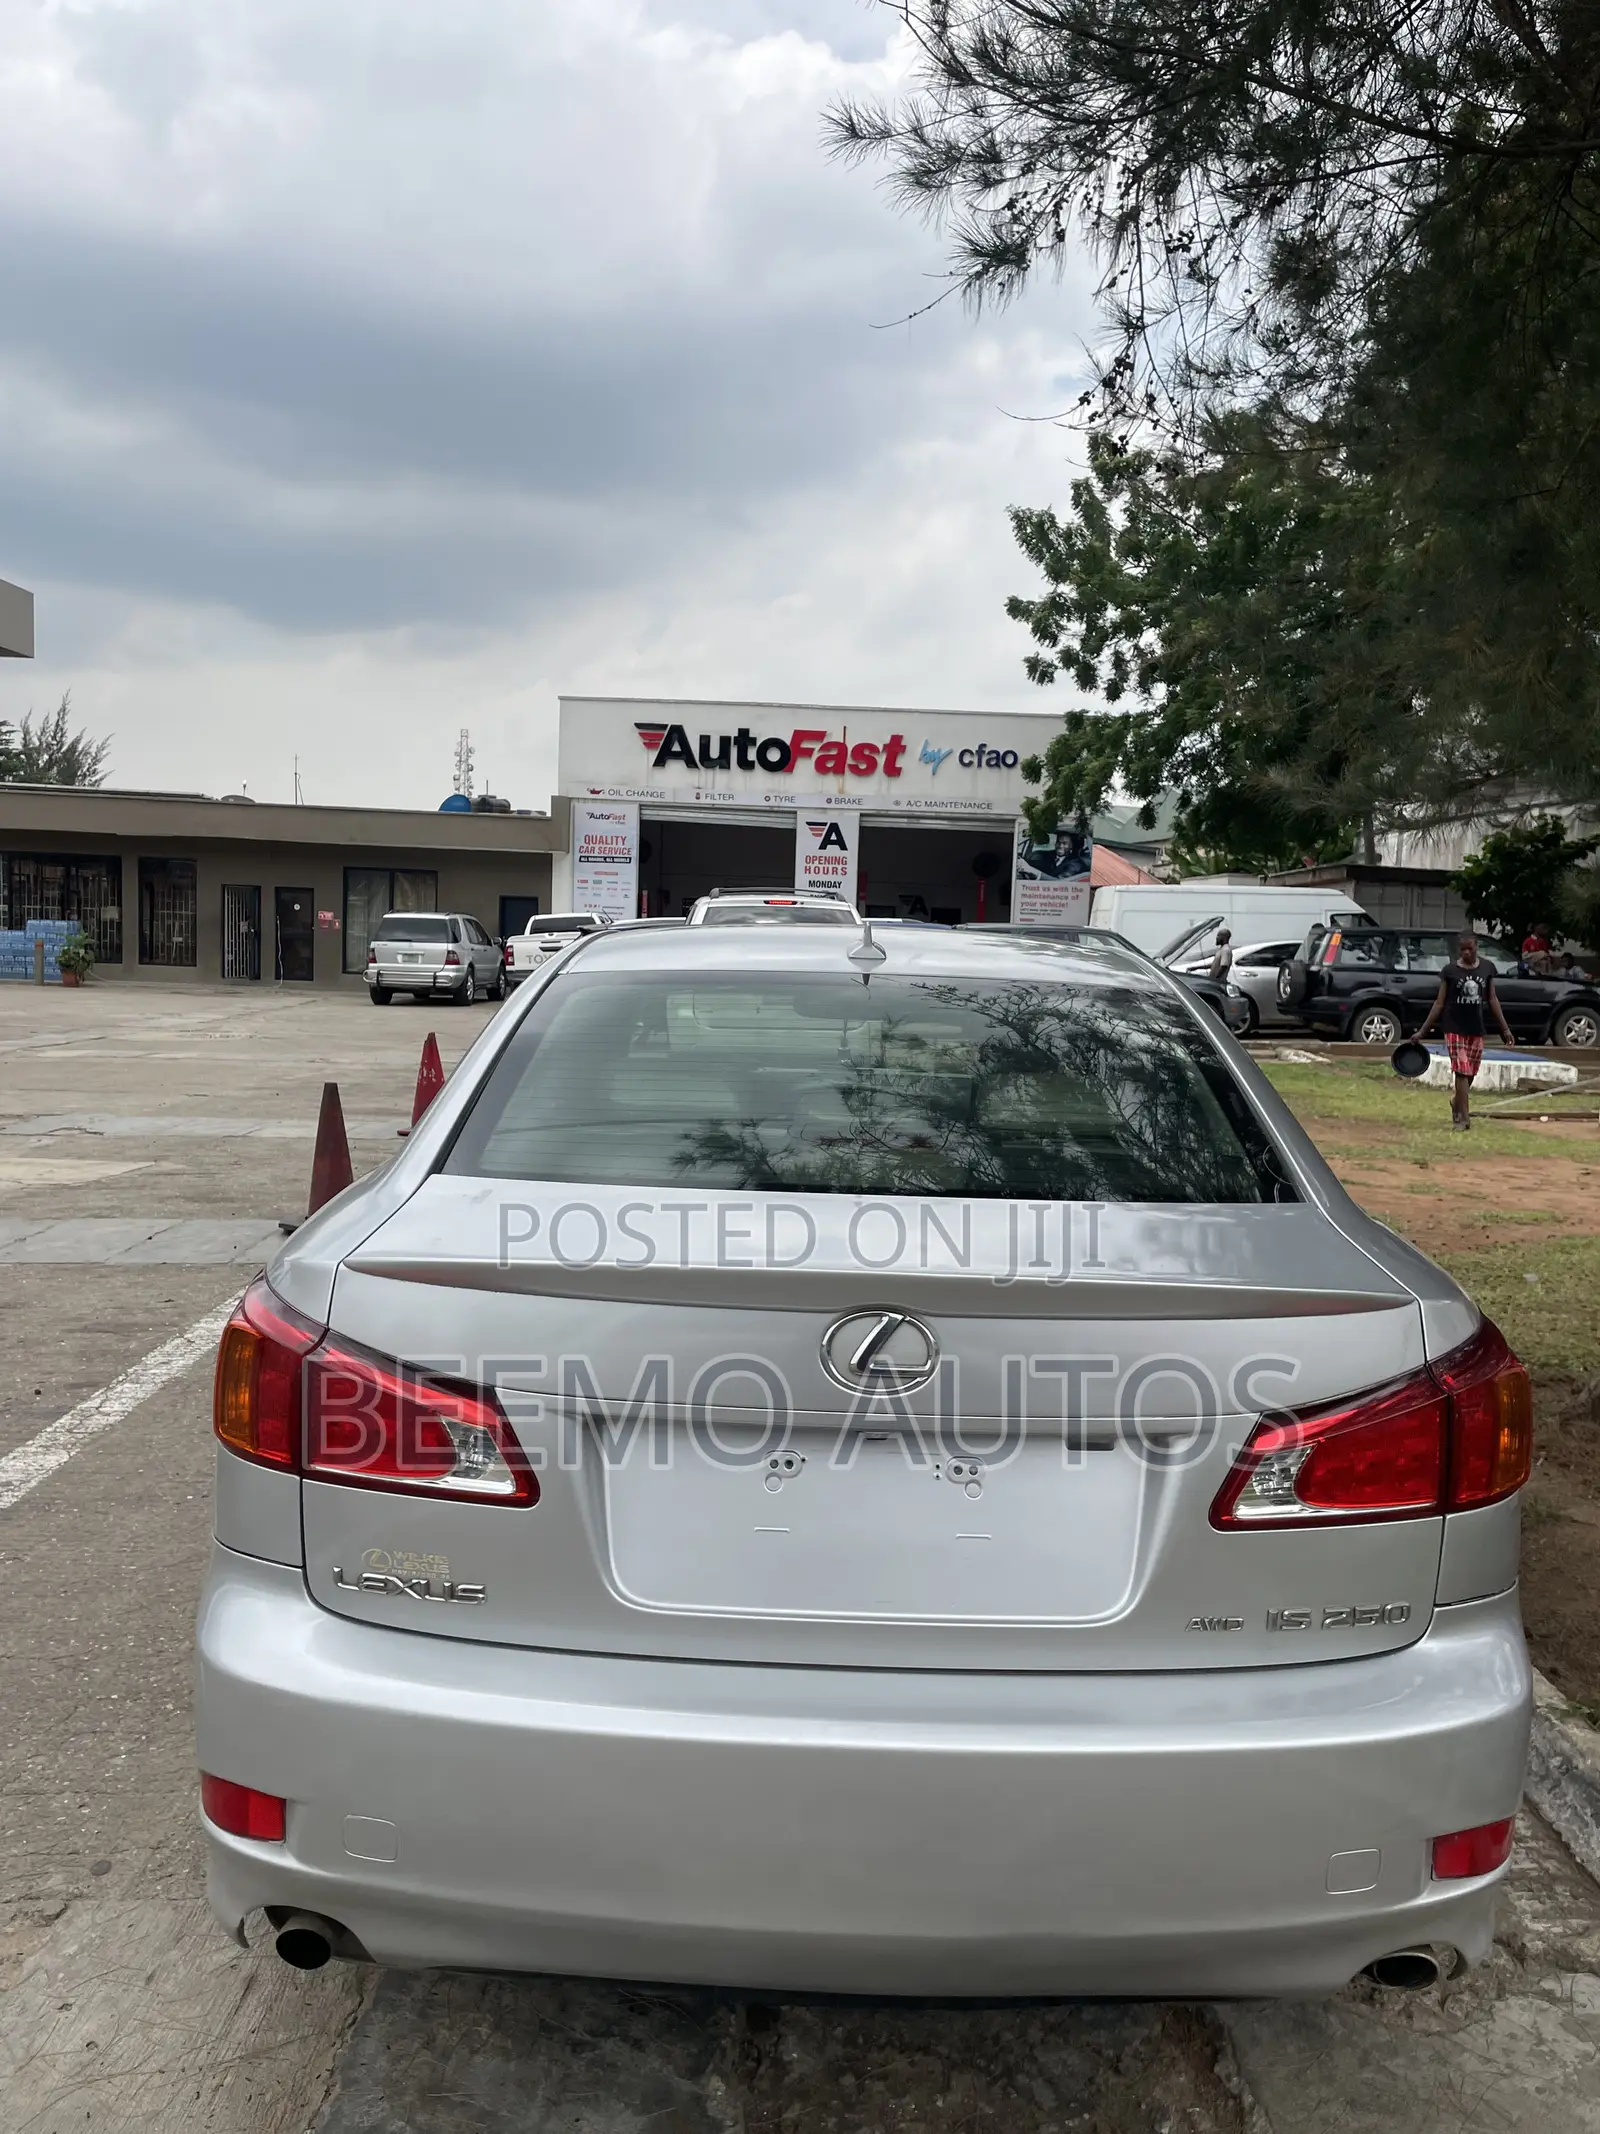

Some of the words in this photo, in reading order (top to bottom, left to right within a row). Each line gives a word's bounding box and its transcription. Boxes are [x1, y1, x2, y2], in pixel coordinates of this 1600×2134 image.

[651, 723, 907, 778] AutoFast
[918, 739, 953, 776] by
[958, 743, 1019, 769] cfao
[607, 788, 622, 797] OIL
[625, 789, 666, 799] CHANGE
[704, 793, 735, 801] FILTER
[773, 795, 796, 804] TYRE
[834, 797, 864, 806] BRAKE
[905, 799, 922, 808] A/C
[924, 800, 993, 810] MAINTENANCE
[584, 834, 627, 846] QUALITY
[578, 845, 596, 855] CAR
[597, 846, 632, 856] SERVICE
[804, 855, 848, 866] OPENING
[804, 865, 848, 876] HOURS
[808, 880, 843, 889] MONDAY
[1021, 884, 1040, 892] Trust
[1071, 886, 1084, 894] the
[1020, 893, 1069, 901] maintenance
[393, 1559, 450, 1573] LEXUS
[332, 1565, 488, 1606] LEXUS
[1185, 1616, 1245, 1632] AWD
[1266, 1607, 1312, 1632] IS
[1321, 1601, 1412, 1630] 250
